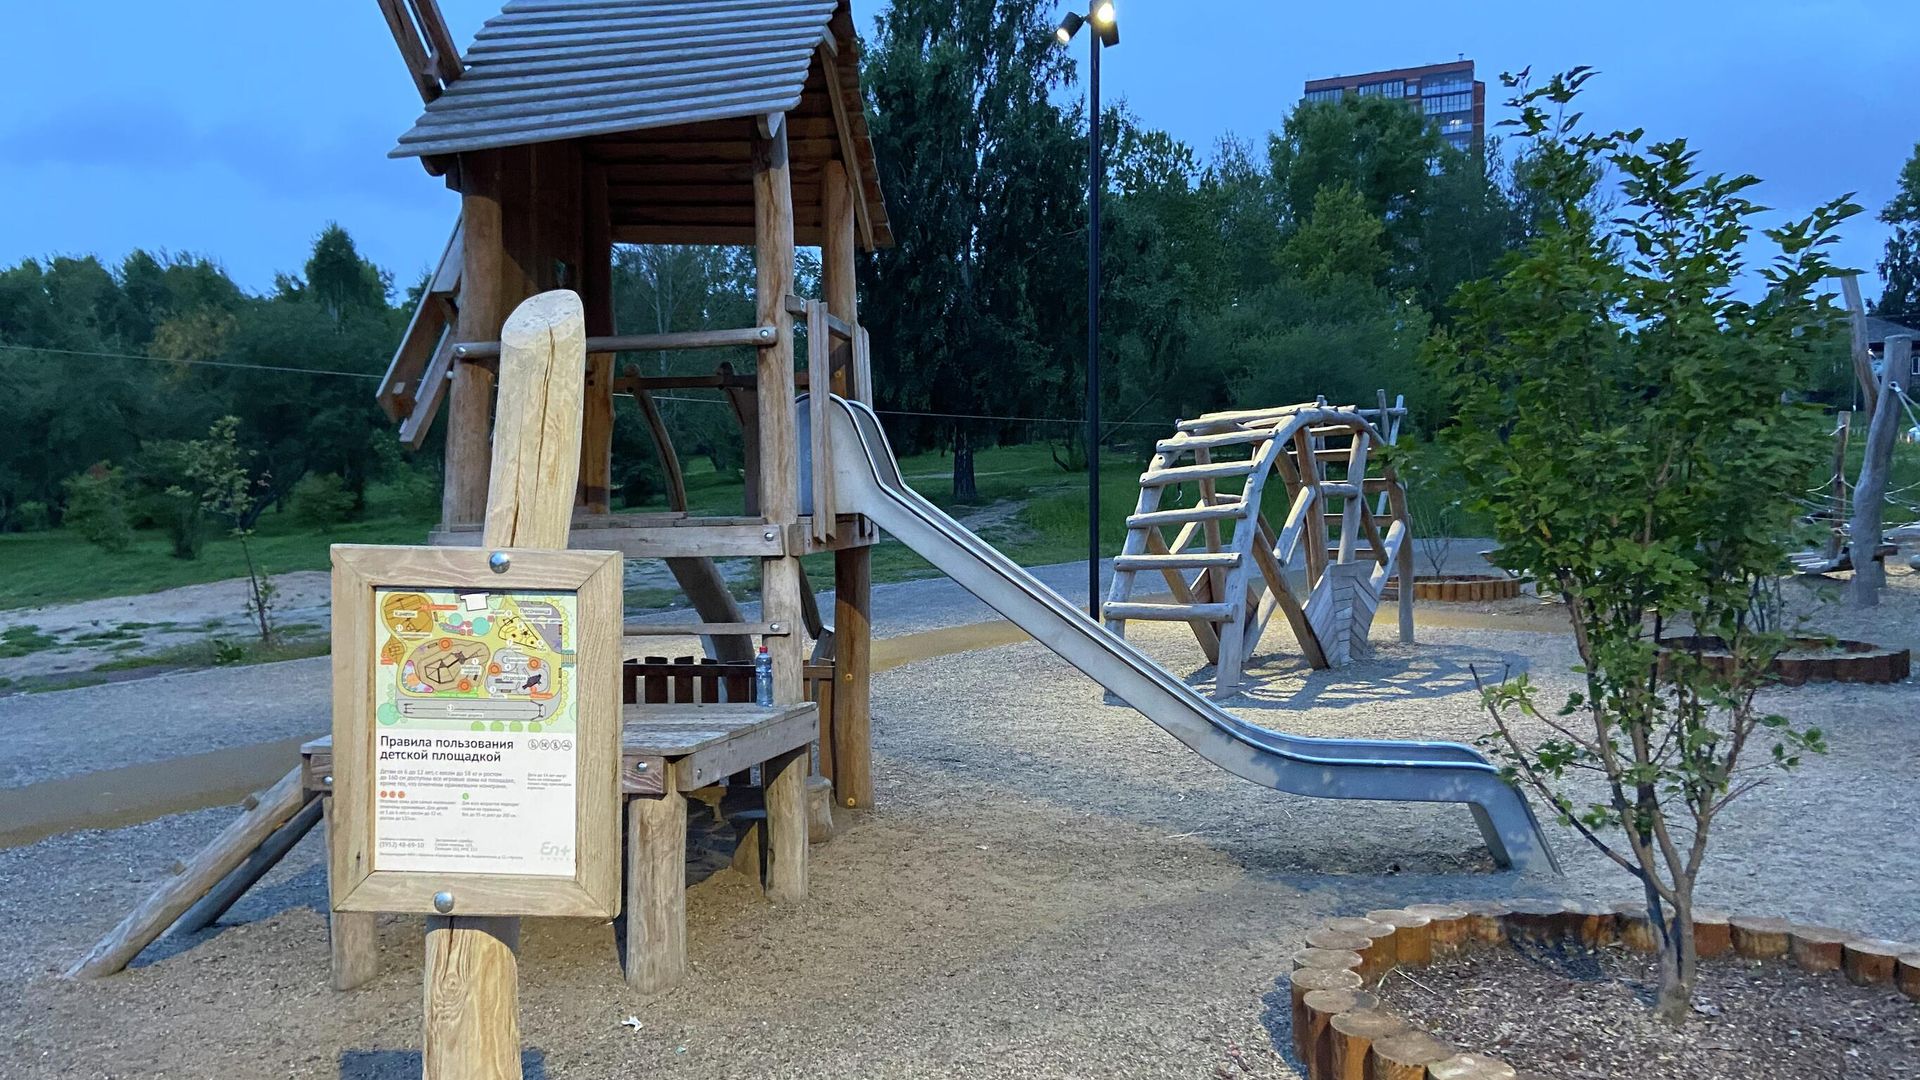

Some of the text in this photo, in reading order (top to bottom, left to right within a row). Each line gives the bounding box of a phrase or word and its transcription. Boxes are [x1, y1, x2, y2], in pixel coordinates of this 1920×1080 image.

[380, 736, 514, 749] Правила пользования
[380, 750, 501, 762] детской площадкой
[540, 841, 571, 856] En+
